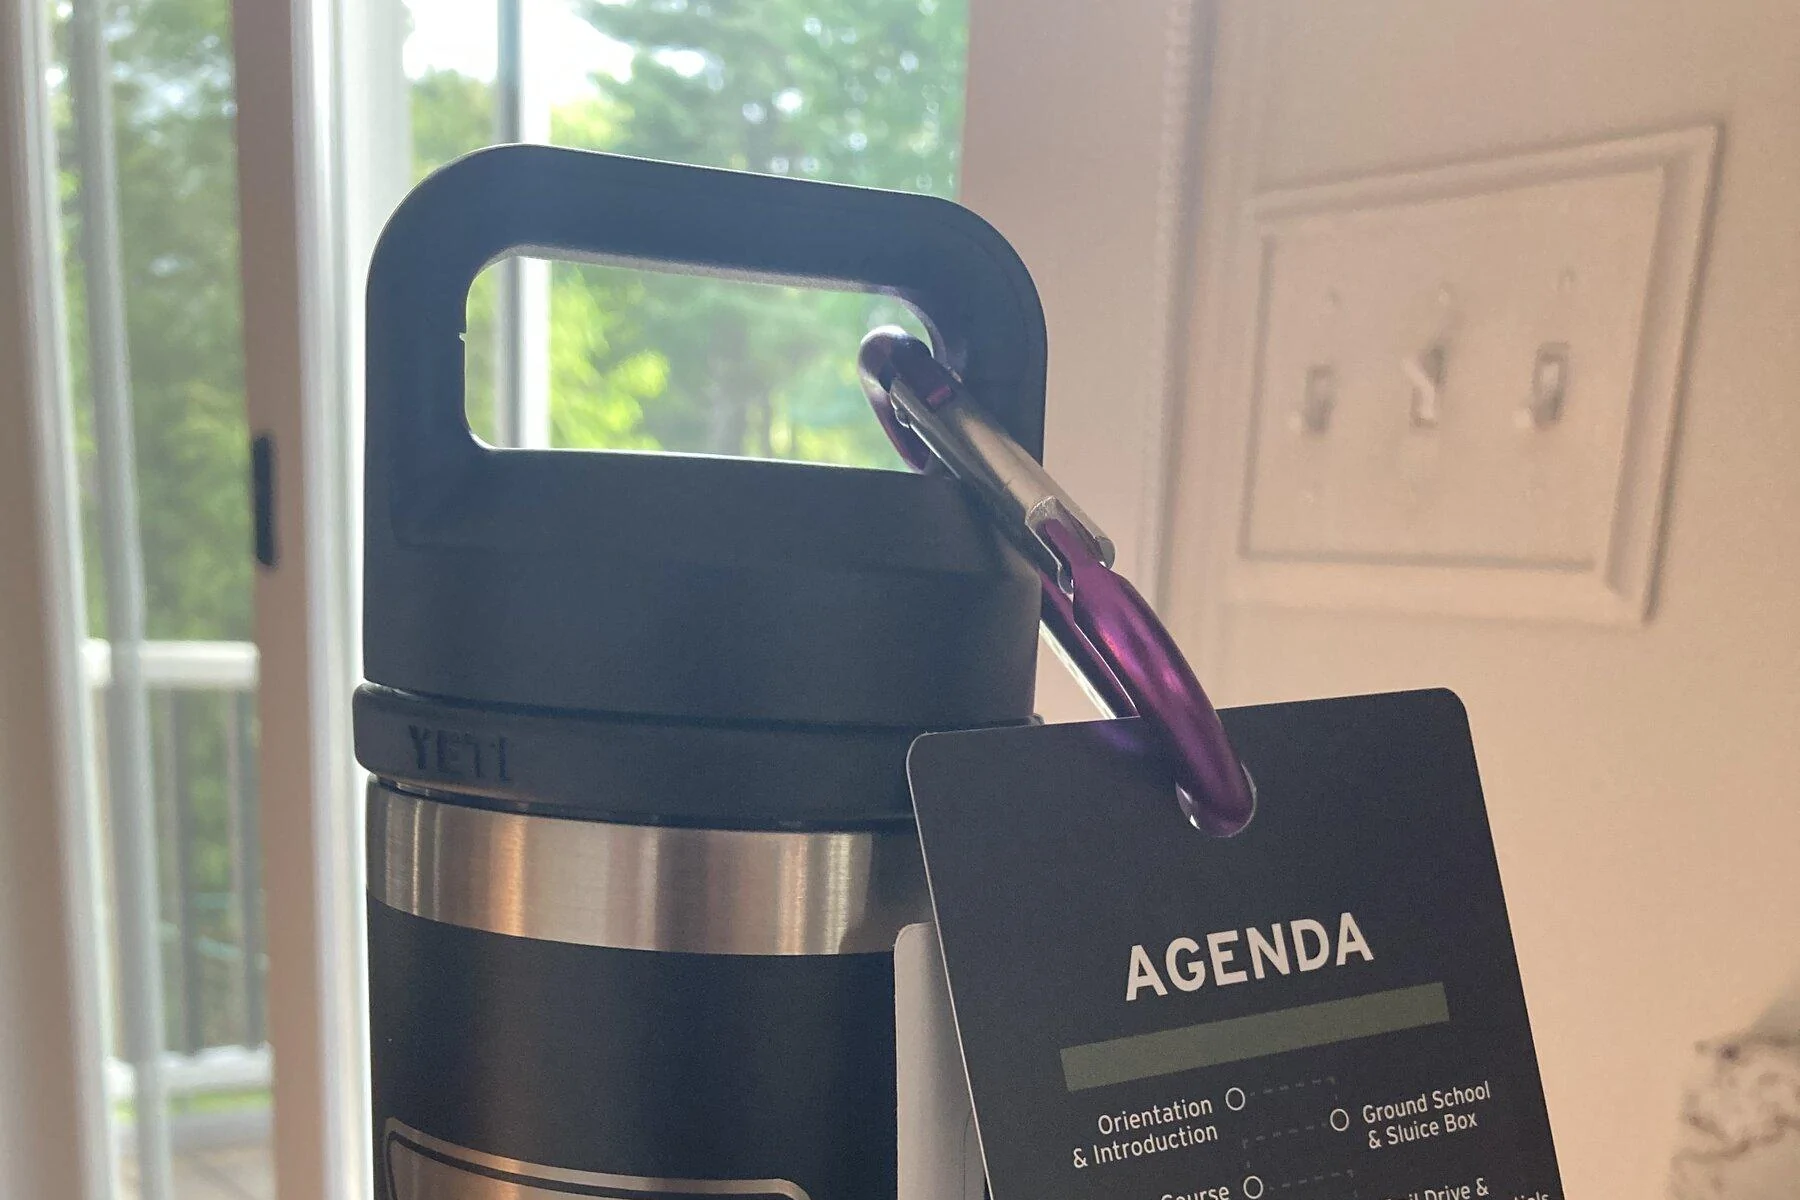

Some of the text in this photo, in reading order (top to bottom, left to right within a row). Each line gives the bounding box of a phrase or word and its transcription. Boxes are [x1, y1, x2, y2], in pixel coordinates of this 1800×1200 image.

[408, 724, 513, 784] YETI
[1126, 912, 1374, 1001] AGENDA
[1098, 1098, 1213, 1135] Orientation
[1363, 1080, 1491, 1124] Ground School
[1073, 1124, 1219, 1169] & Introduction
[1367, 1111, 1478, 1150] & Sluice Box
[1475, 1177, 1490, 1197] &
